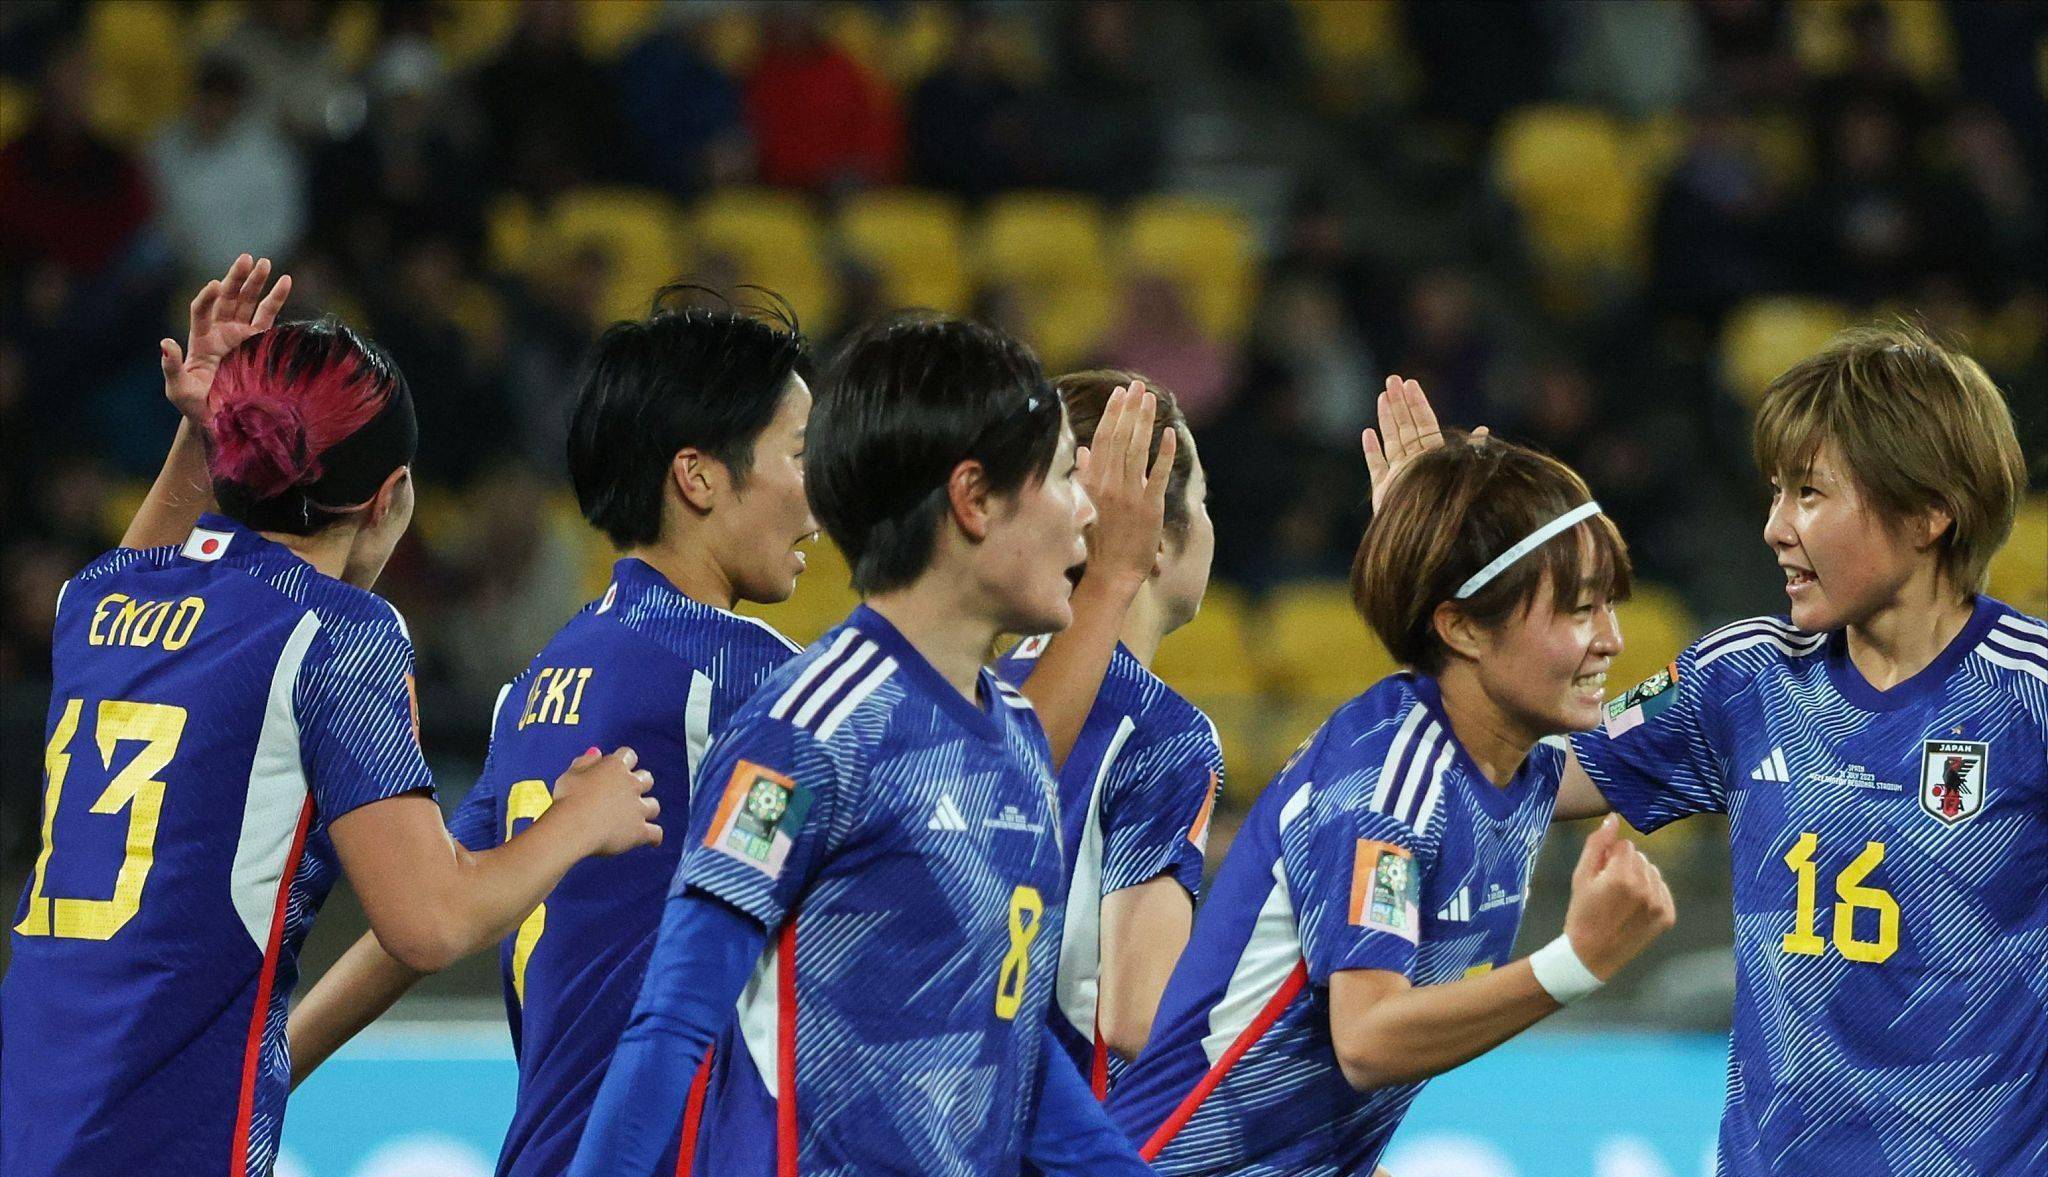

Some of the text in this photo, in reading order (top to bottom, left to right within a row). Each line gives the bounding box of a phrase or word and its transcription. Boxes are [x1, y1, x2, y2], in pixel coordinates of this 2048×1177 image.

[89, 593, 205, 651] ENDO
[1939, 744, 1972, 752] JAPAN
[14, 698, 187, 941] 13
[995, 885, 1044, 1020] 8
[1783, 832, 1900, 964] 16
